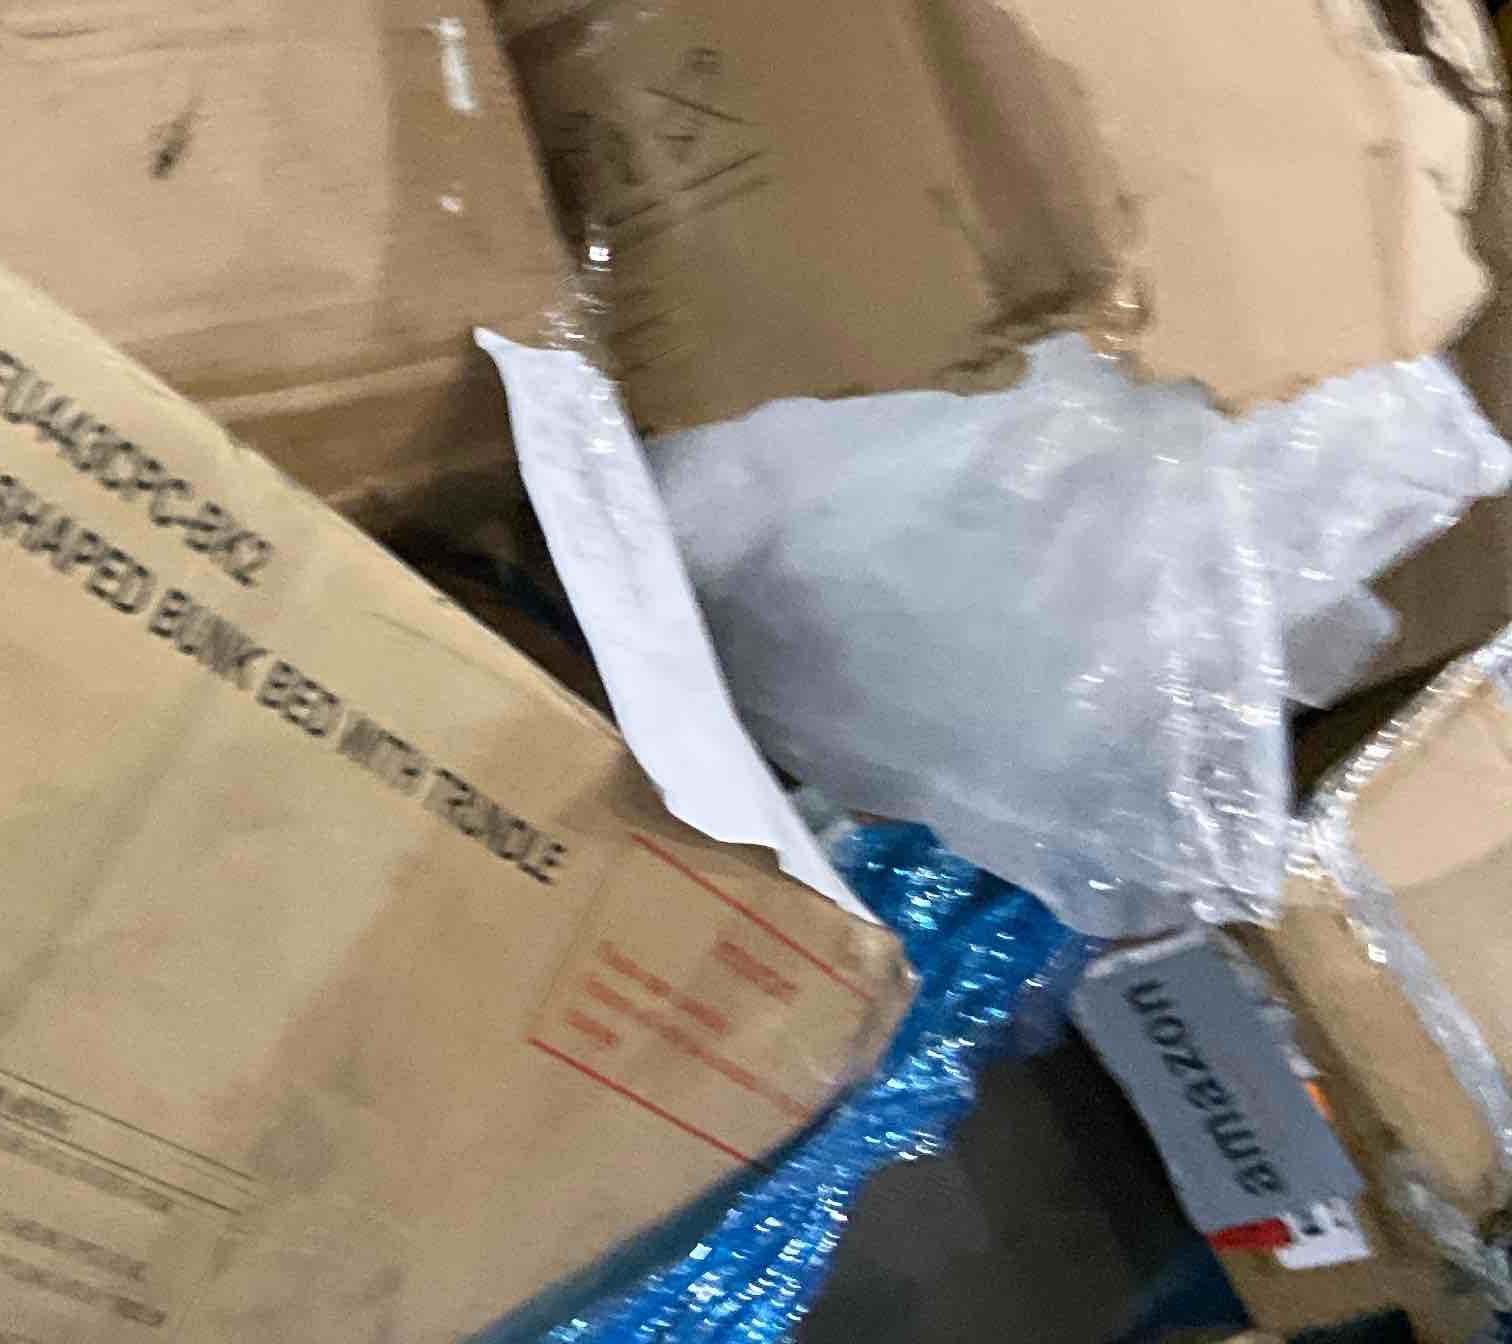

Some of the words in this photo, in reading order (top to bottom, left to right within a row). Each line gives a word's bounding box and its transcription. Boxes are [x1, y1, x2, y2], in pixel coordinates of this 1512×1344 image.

[147, 586, 269, 693] BUNK
[256, 660, 341, 739] BED
[337, 707, 430, 797] WITH
[1128, 979, 1287, 1196] amazon
